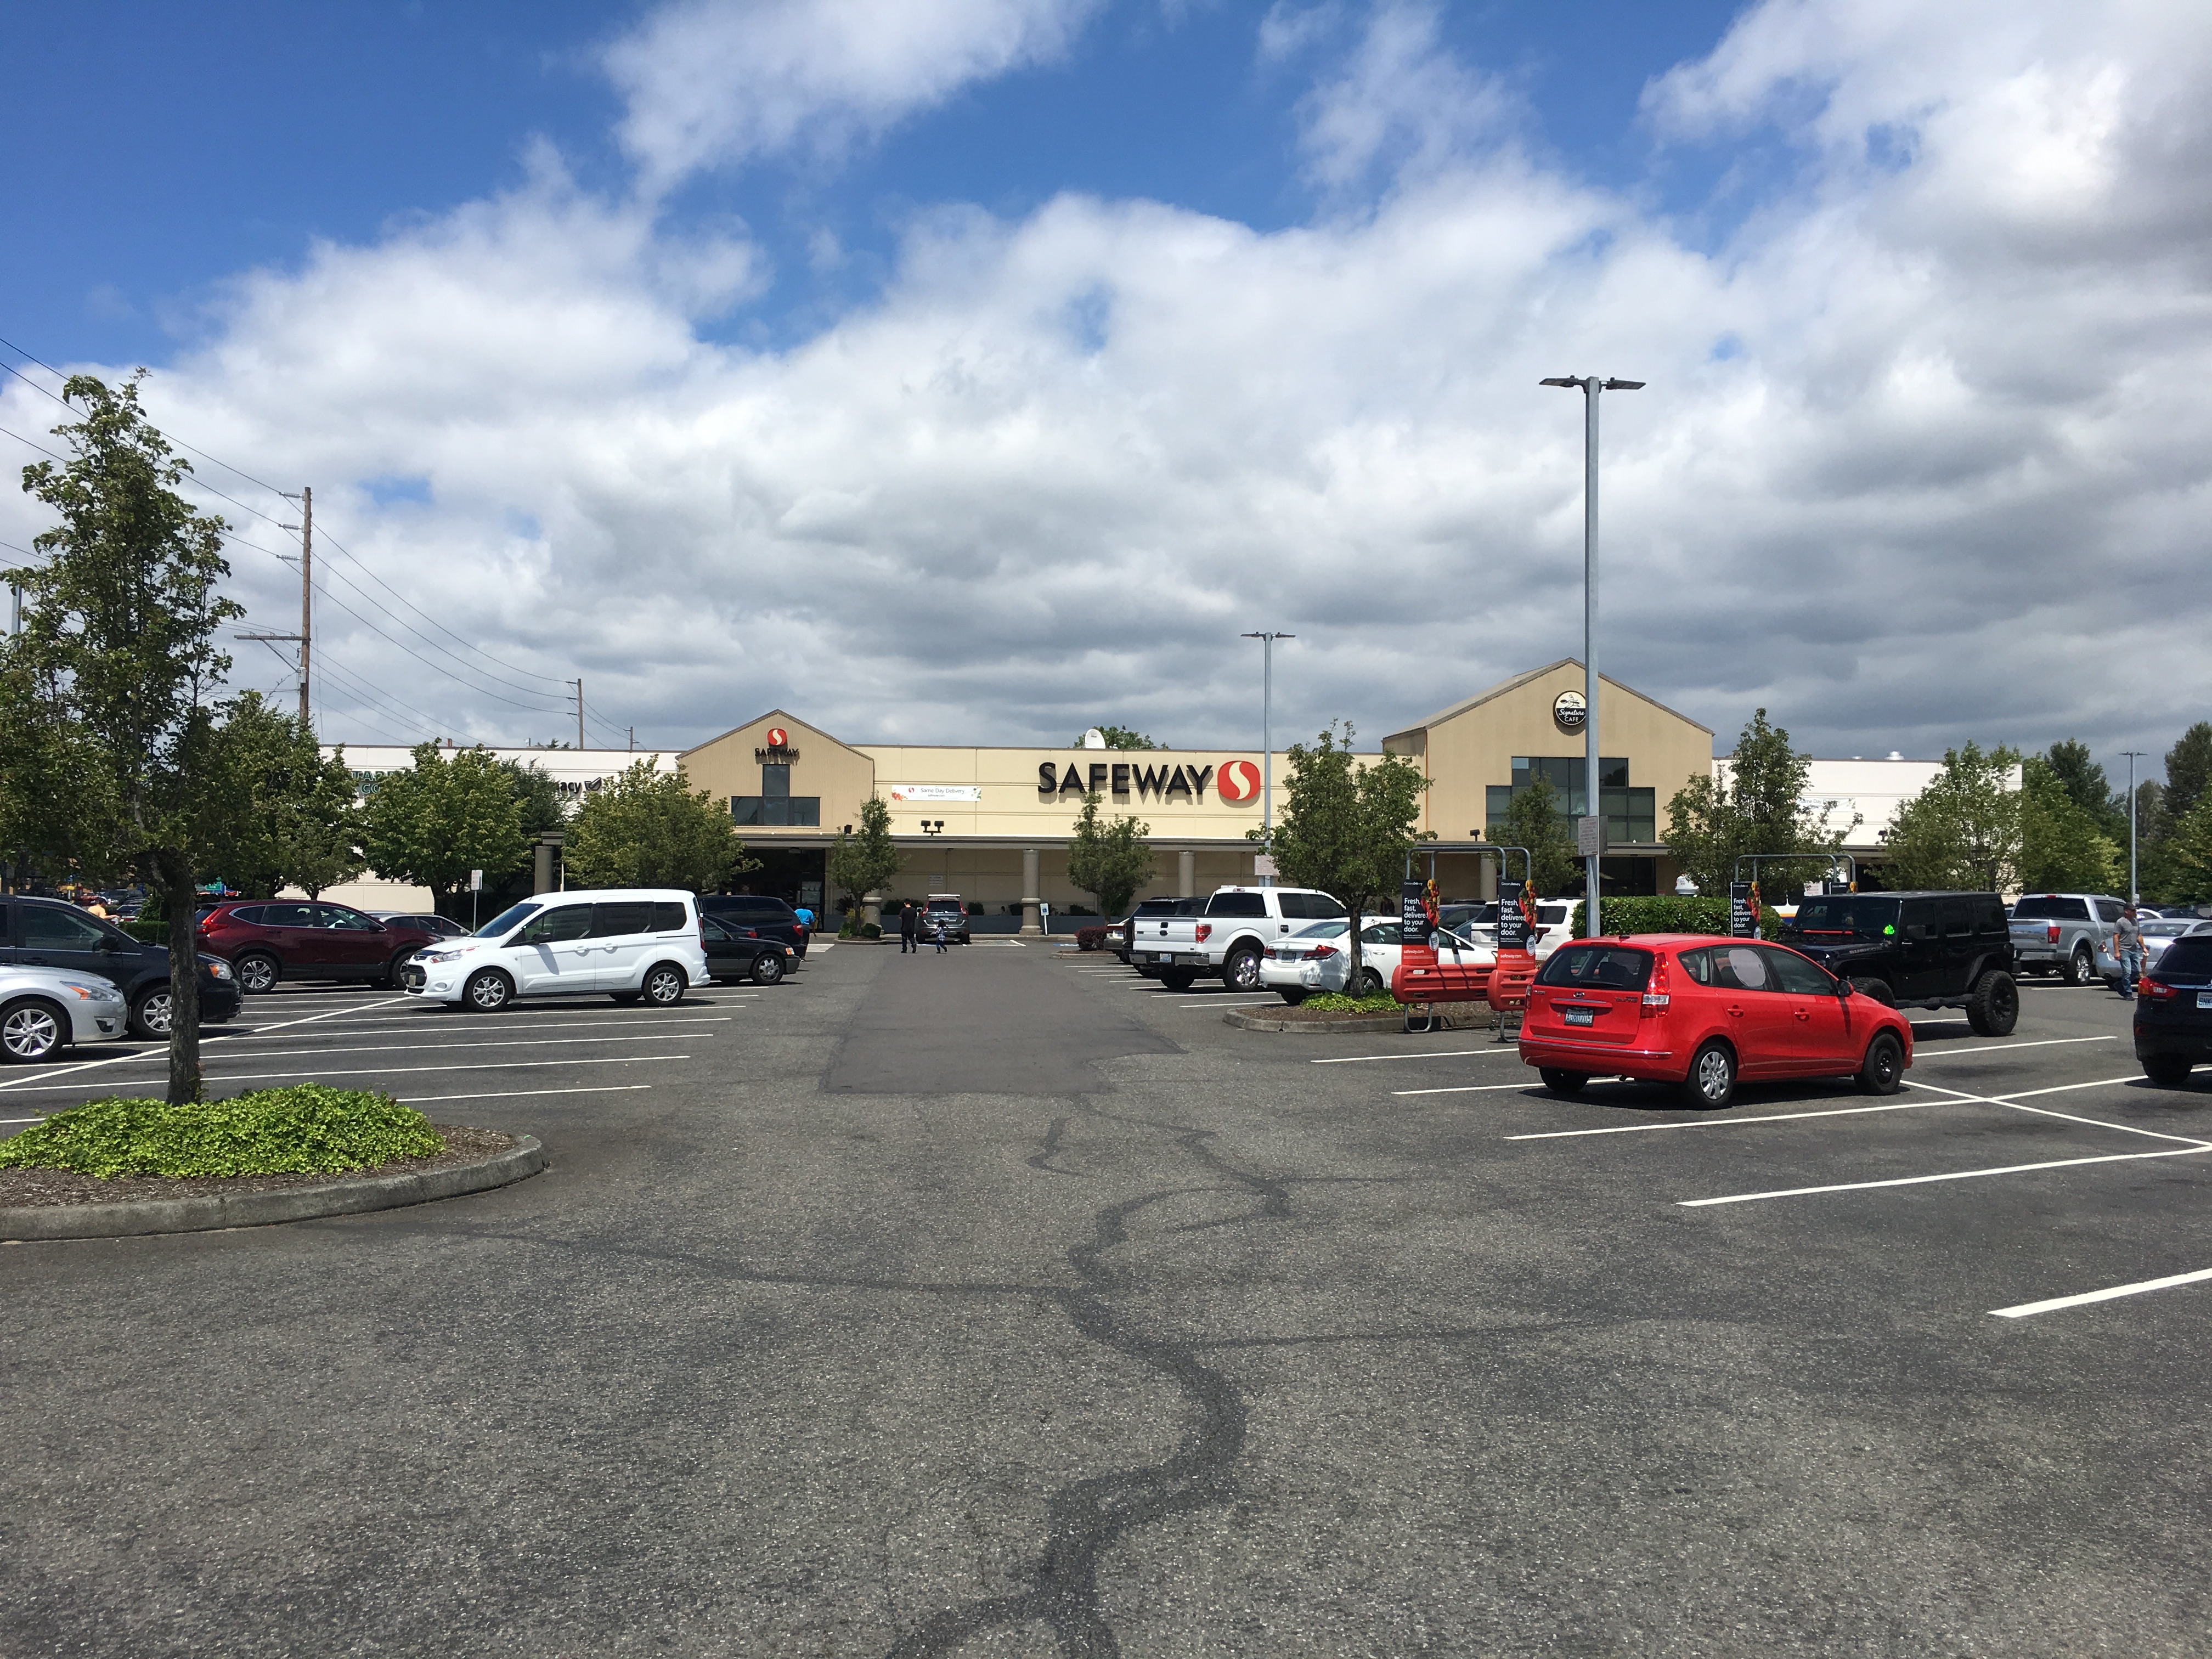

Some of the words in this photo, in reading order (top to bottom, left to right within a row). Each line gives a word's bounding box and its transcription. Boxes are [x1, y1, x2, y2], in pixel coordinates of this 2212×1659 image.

[1559, 709, 1585, 717] Signature
[755, 748, 799, 756] SAFEWAY
[1038, 762, 1213, 794] SAFEWAY
[560, 782, 582, 794] acy
